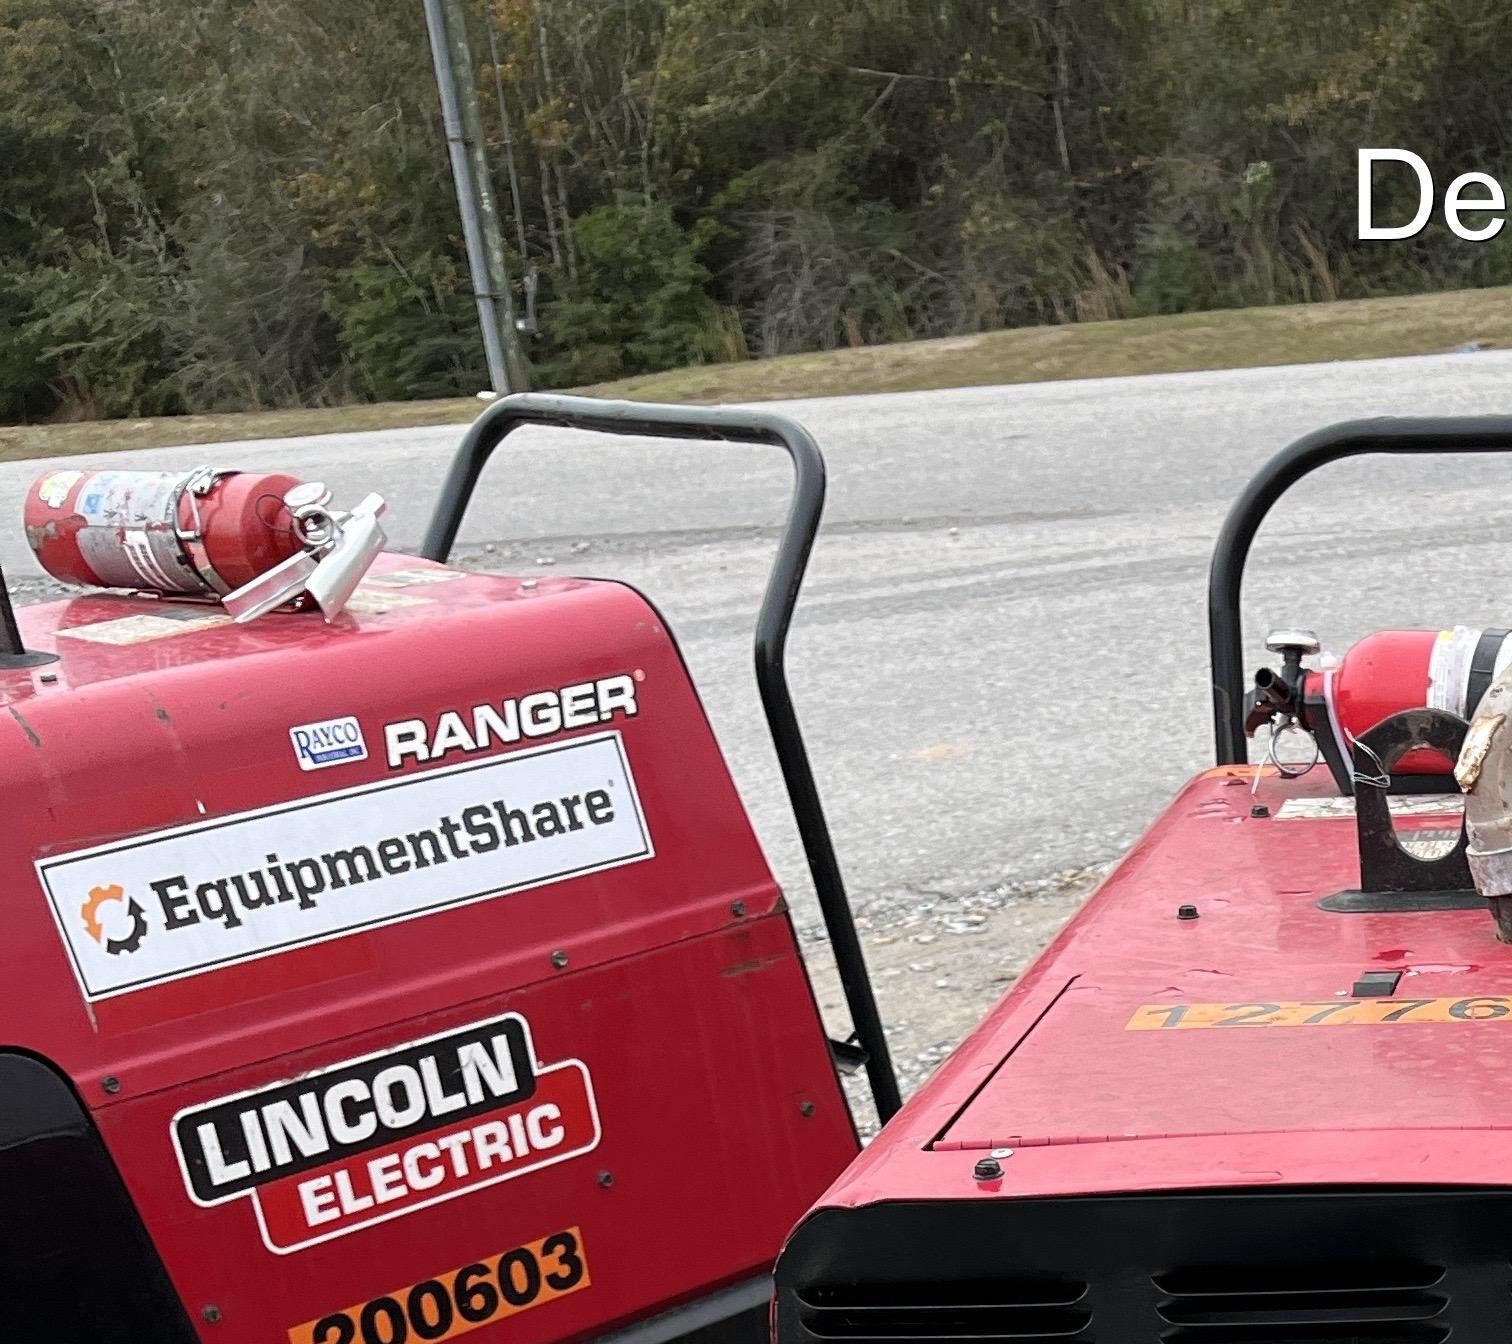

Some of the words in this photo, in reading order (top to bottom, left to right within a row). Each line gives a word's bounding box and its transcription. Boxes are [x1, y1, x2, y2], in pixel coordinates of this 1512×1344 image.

[293, 722, 358, 758] RAYCO
[384, 673, 638, 769] RANGER
[149, 787, 615, 930] EquipmentShare
[196, 1034, 519, 1187] LINCOLN
[298, 1103, 565, 1227] ELECTRIC
